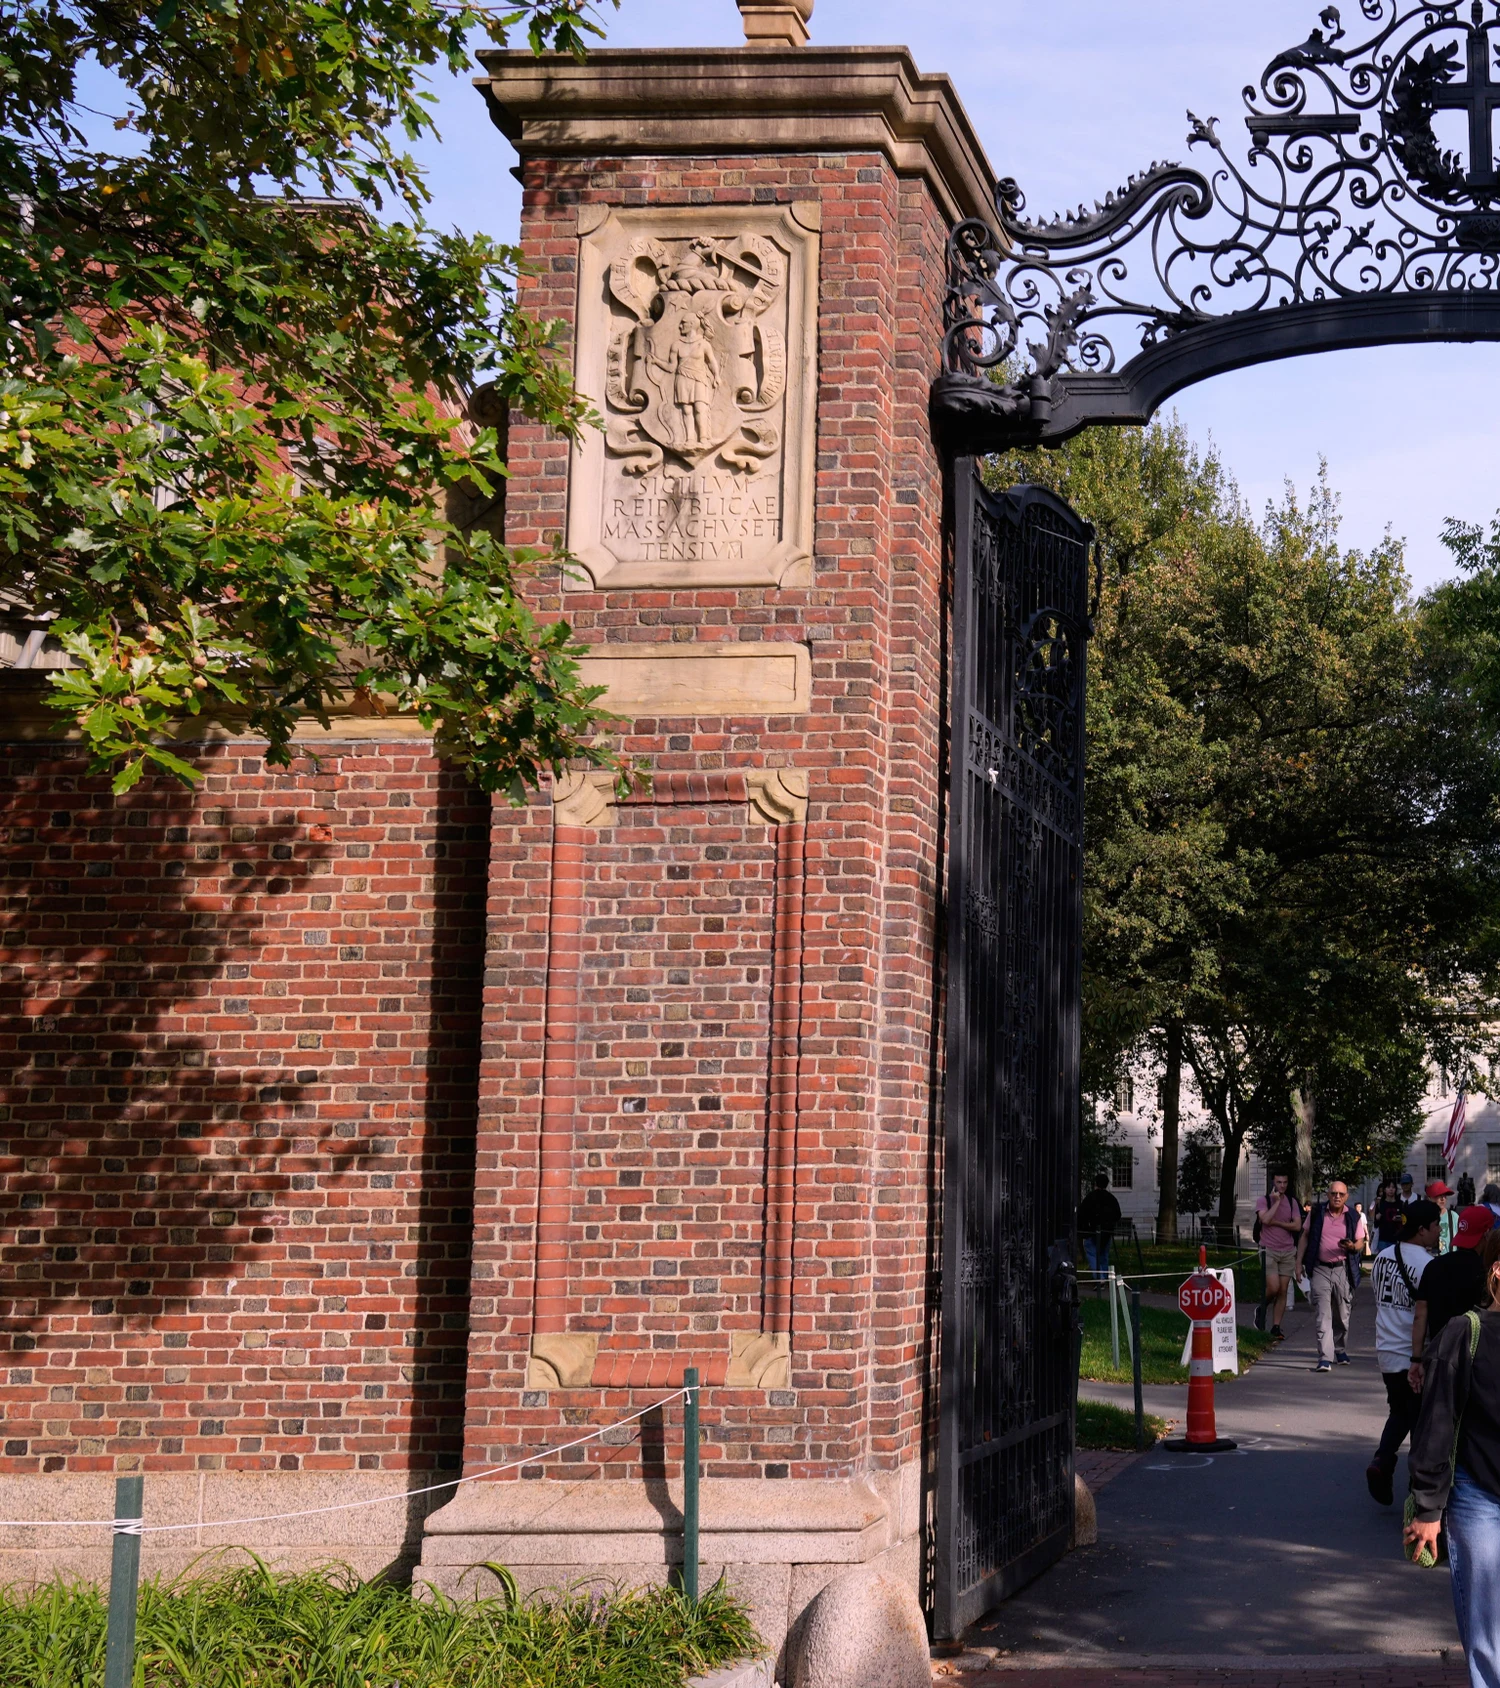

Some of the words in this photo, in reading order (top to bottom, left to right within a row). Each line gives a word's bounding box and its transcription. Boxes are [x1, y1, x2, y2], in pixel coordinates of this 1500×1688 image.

[638, 475, 750, 496] SIGILLVM
[613, 496, 776, 517] REIPVBLICAE
[604, 518, 782, 539] MASSACHVSET
[639, 541, 744, 560] TENSIVM
[1181, 1289, 1224, 1307] STOP
